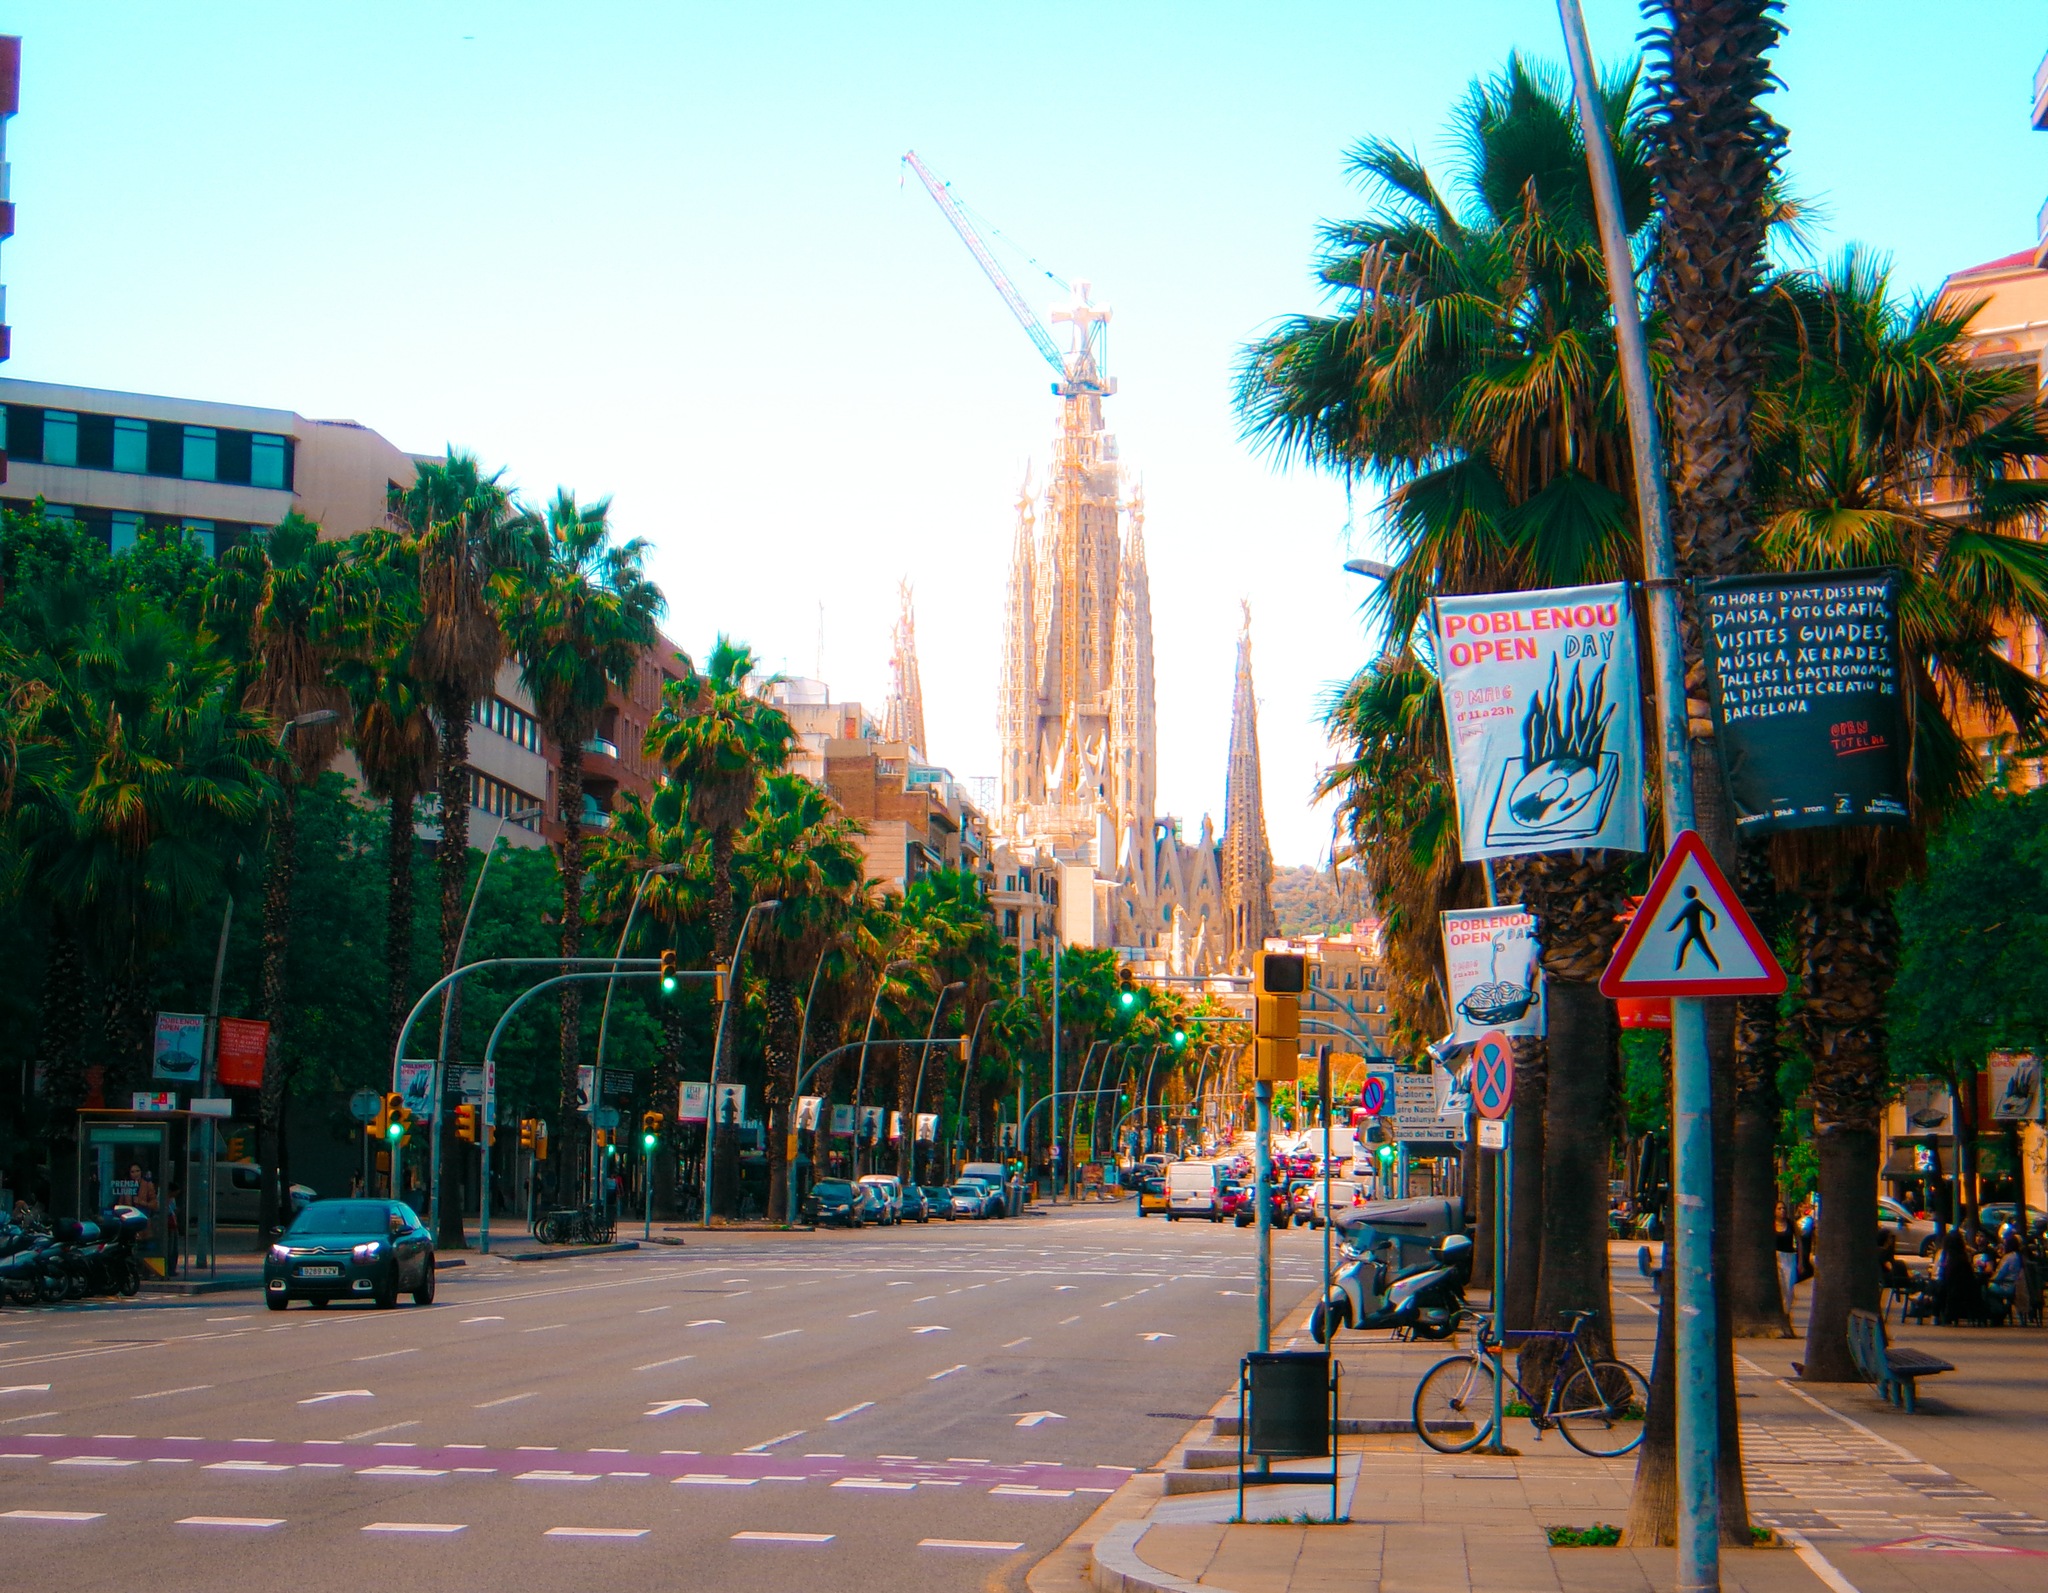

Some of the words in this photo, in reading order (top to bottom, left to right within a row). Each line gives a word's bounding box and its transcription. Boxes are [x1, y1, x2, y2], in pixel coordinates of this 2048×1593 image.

[1728, 592, 1773, 606] HORES
[1445, 603, 1619, 639] POBLENOU
[1711, 609, 1777, 630] DANSA,
[1779, 602, 1888, 620] FOTOGRAFIA,
[1565, 630, 1615, 660] DAY
[1715, 628, 1787, 649] VISITES
[1799, 623, 1888, 643] GUIADES,
[1449, 637, 1538, 667] OPEN
[1716, 648, 1790, 673] MÚSICA,
[1718, 669, 1779, 689] TALLERS
[1794, 664, 1892, 679] GASTRONOMIA
[1454, 690, 1464, 708] 9
[1468, 684, 1512, 705] MAIG
[1722, 691, 1739, 705] AL
[1741, 683, 1814, 703] DISTRICTE
[1815, 681, 1874, 694] CREATIU
[1880, 682, 1893, 695] DE
[1723, 700, 1808, 724] BARCELONA
[1830, 720, 1868, 736] OPEN
[1831, 737, 1853, 750] TOT
[1856, 737, 1868, 747] EL
[1449, 914, 1531, 932] POBLENOU
[1450, 931, 1491, 946] OPEN
[1404, 1076, 1425, 1084] Corts
[1398, 1115, 1436, 1124] Catalunya
[110, 1180, 140, 1188] PREMSA
